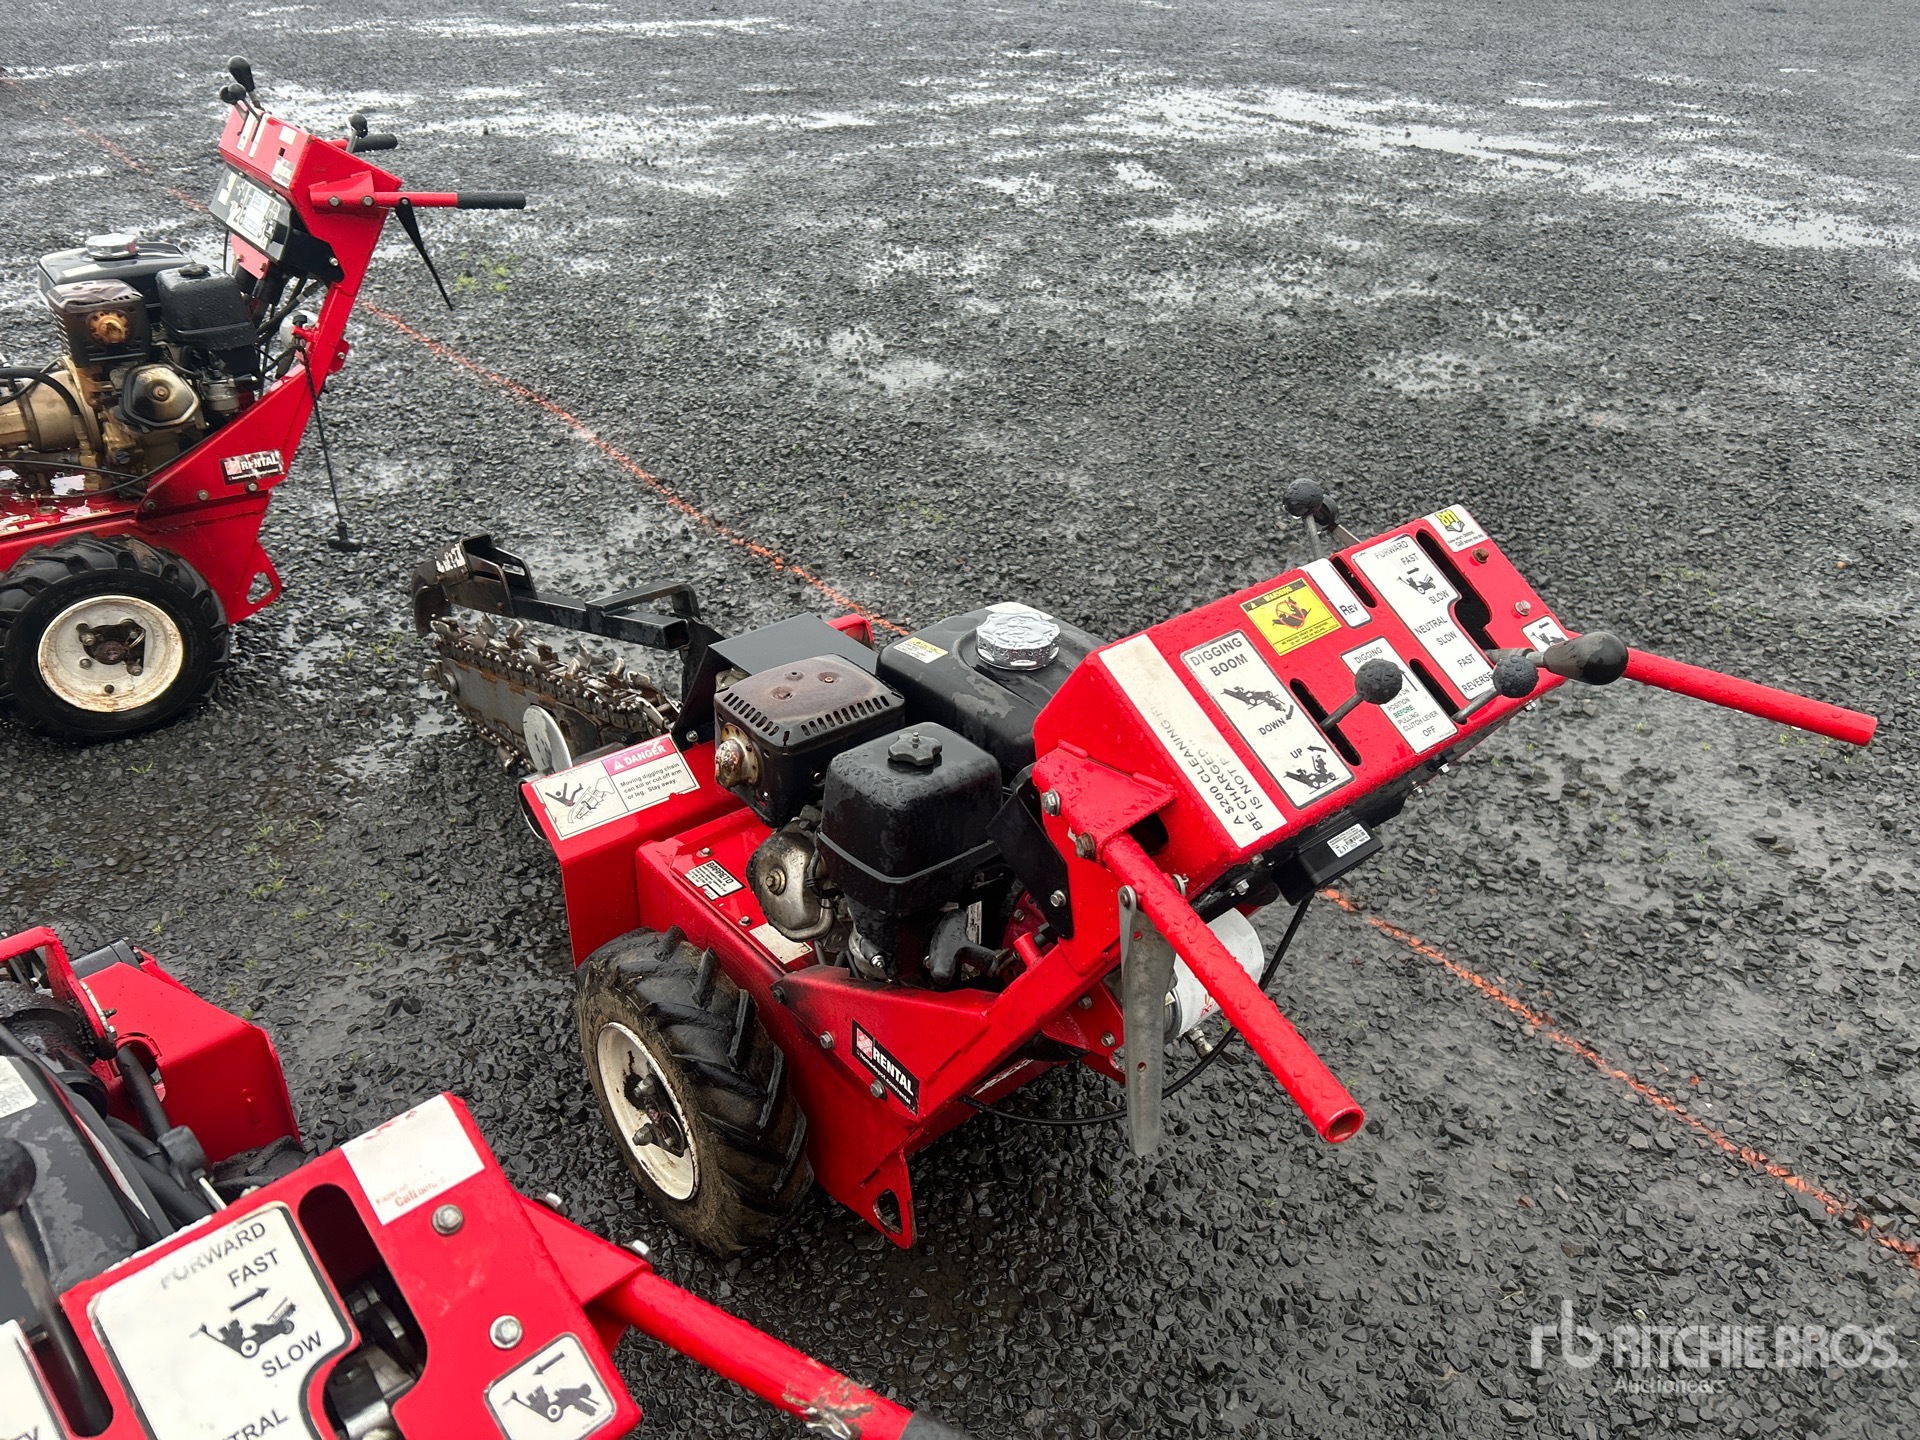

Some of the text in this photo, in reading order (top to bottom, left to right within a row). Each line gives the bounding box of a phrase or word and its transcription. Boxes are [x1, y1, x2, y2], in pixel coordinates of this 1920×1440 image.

[1434, 509, 1459, 527] 811
[1374, 540, 1409, 560] FORWARD
[1400, 552, 1420, 566] FAST
[1428, 589, 1450, 605] SLOW
[1414, 616, 1448, 636] NEUTRAL
[1436, 630, 1458, 646] SLOW
[1189, 637, 1243, 667] DIGGING
[1354, 646, 1383, 664] DIGGING
[1456, 653, 1476, 668] FAST
[1209, 653, 1249, 677] BOOM
[1386, 697, 1411, 712] POSITION
[1392, 704, 1415, 719] BEFORE
[1258, 717, 1287, 736] DOWN
[1397, 711, 1420, 726] PULLING
[1402, 710, 1439, 732] CLUTCH LEVER
[1422, 725, 1437, 737] OFF
[623, 744, 667, 765] DANGER
[1160, 719, 1211, 784] CLEANING
[1289, 747, 1303, 760] UP
[620, 763, 680, 787] Moving digging chain
[647, 784, 661, 793] Stay
[1197, 748, 1264, 832] BE CHARGED
[1227, 769, 1264, 810] IS NOT
[1209, 785, 1235, 814] $200
[1233, 814, 1245, 826] A
[706, 862, 734, 884] BARRETO
[873, 1046, 914, 1096] RENTAL
[227, 1247, 281, 1288] FAST
[261, 1330, 323, 1379] SLOW
